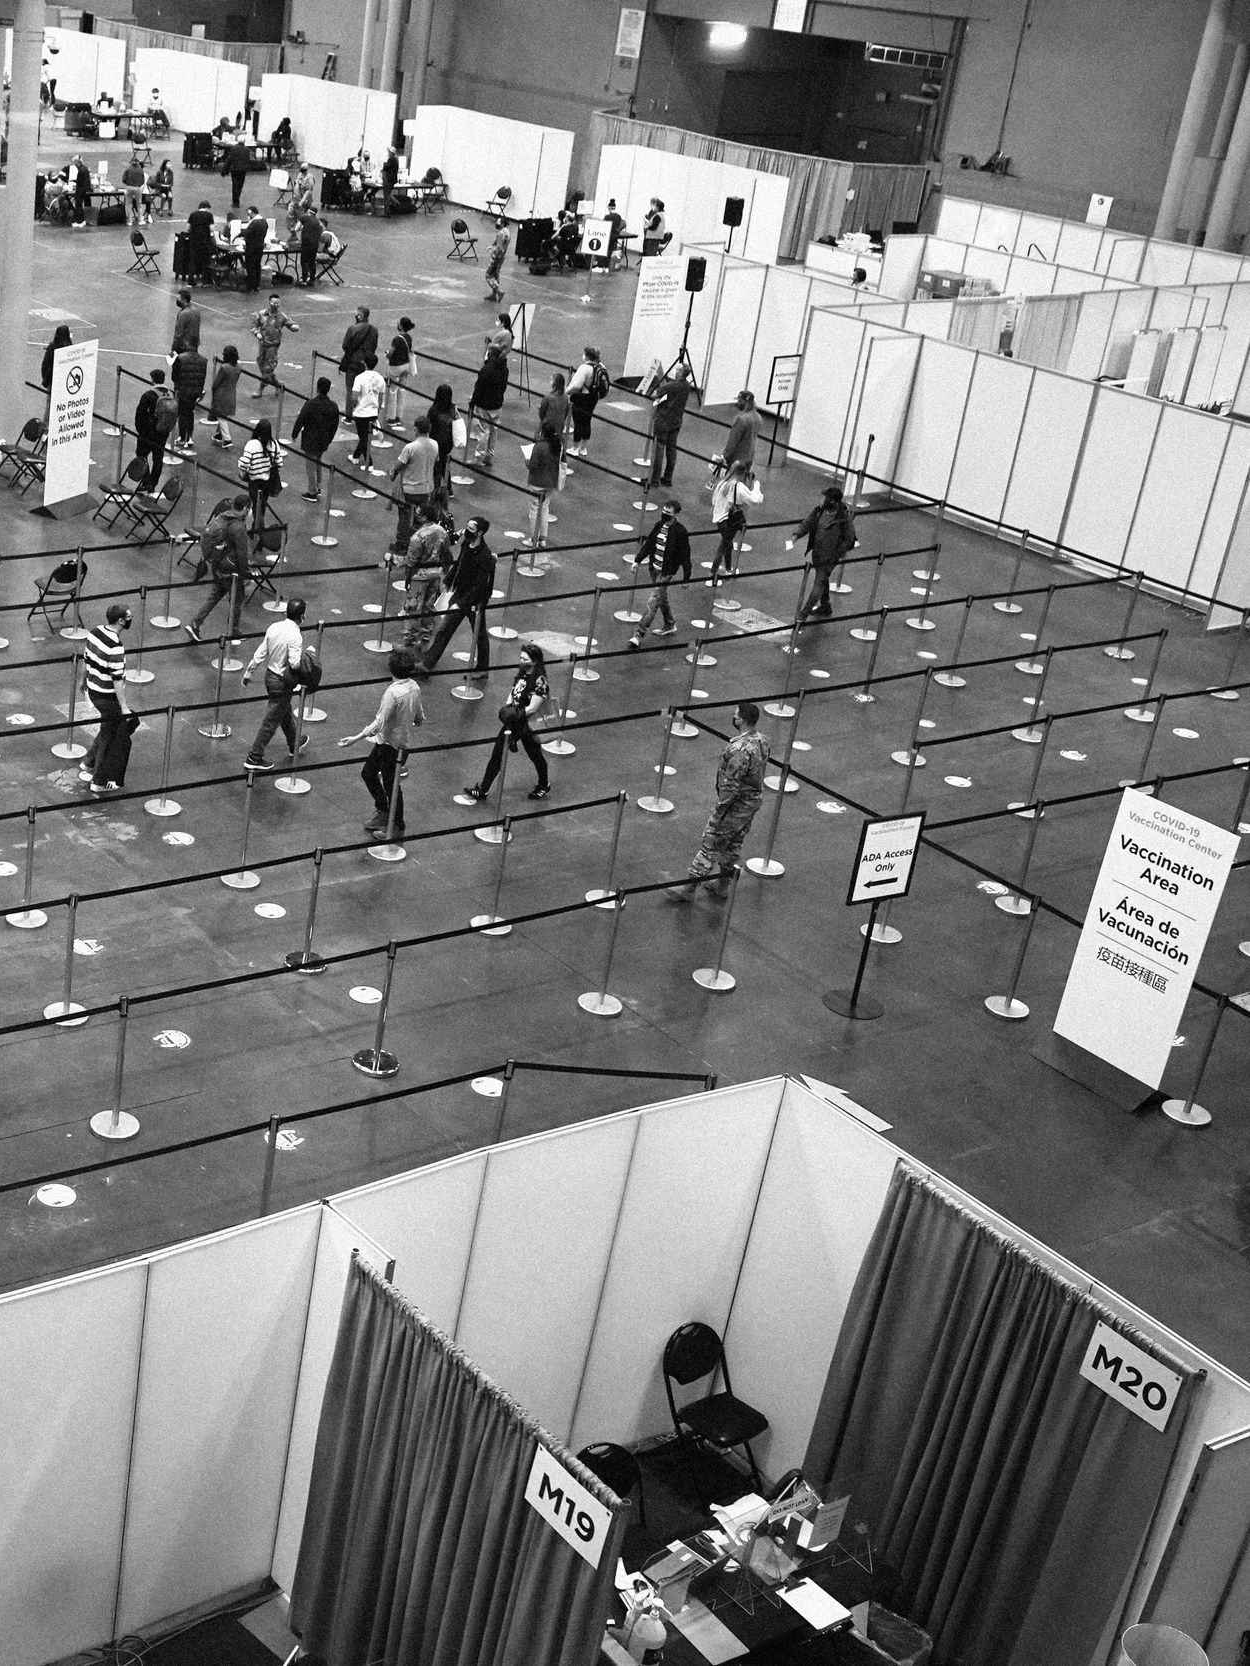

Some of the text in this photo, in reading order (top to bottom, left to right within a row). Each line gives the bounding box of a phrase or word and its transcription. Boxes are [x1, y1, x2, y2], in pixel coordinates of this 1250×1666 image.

[587, 229, 607, 238] Lane
[56, 397, 90, 412] No Photos
[58, 409, 86, 423] or Video
[51, 430, 87, 447] in this Area
[58, 419, 85, 433] Allowed
[1129, 810, 1223, 861] Vaccination Center
[1152, 810, 1200, 838] COVID-19
[861, 848, 913, 863] ADA Access
[874, 862, 896, 873] Only
[1121, 834, 1214, 891] Vaccination
[1139, 867, 1180, 896] Area
[1115, 896, 1180, 940] Área de
[1099, 907, 1189, 966] Vacunación
[1096, 946, 1169, 994] 疫苗接種區
[1091, 1343, 1167, 1411] M20
[538, 1472, 595, 1543] M19
[772, 1507, 782, 1515] DO
[782, 1503, 795, 1512] NOT
